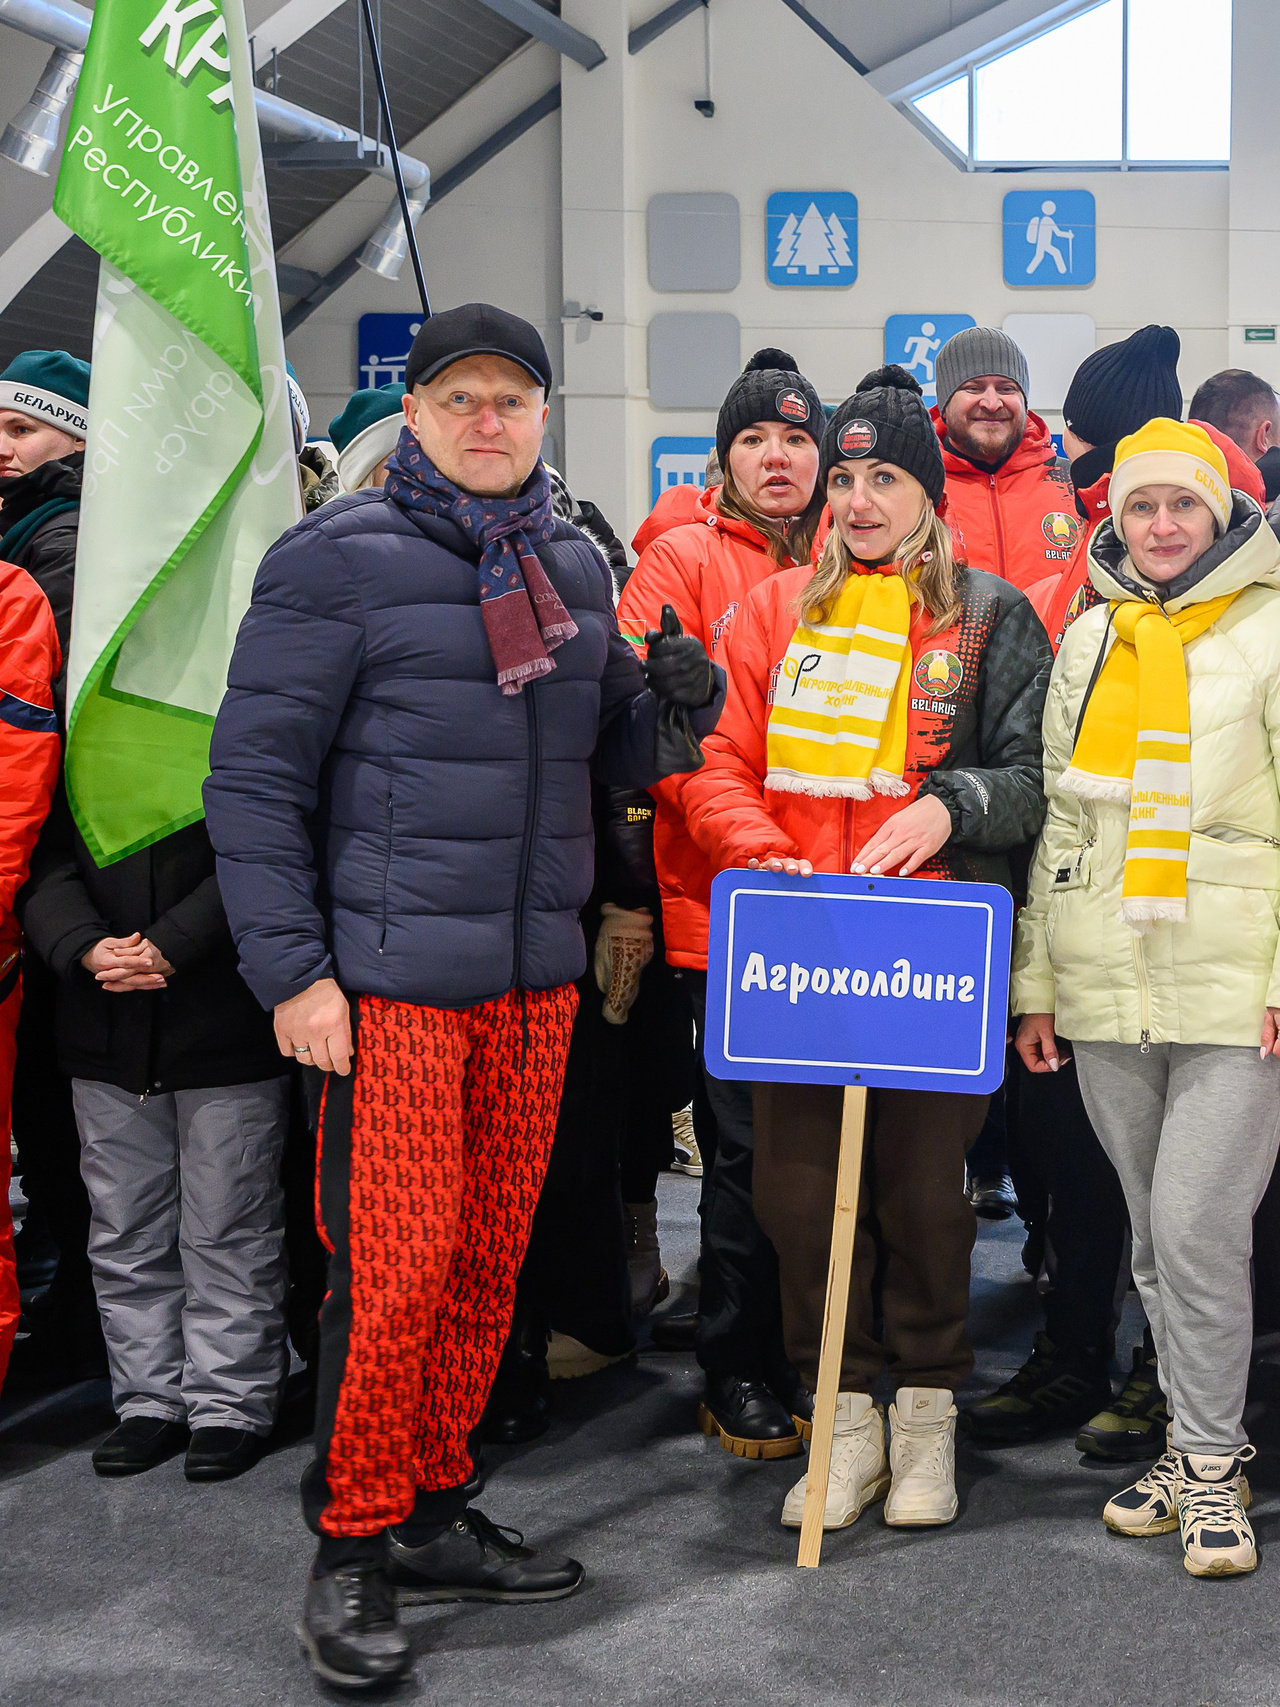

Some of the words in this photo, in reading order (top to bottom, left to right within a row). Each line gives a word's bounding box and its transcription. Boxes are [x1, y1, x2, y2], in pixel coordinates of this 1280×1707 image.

[93, 83, 249, 246] Управлен
[67, 125, 253, 307] Республики
[13, 391, 88, 431] БЕЛАРУСЬ
[911, 698, 957, 716] BELARUS
[627, 807, 652, 816] BLACK
[740, 951, 976, 1005] Агрохолдинг
